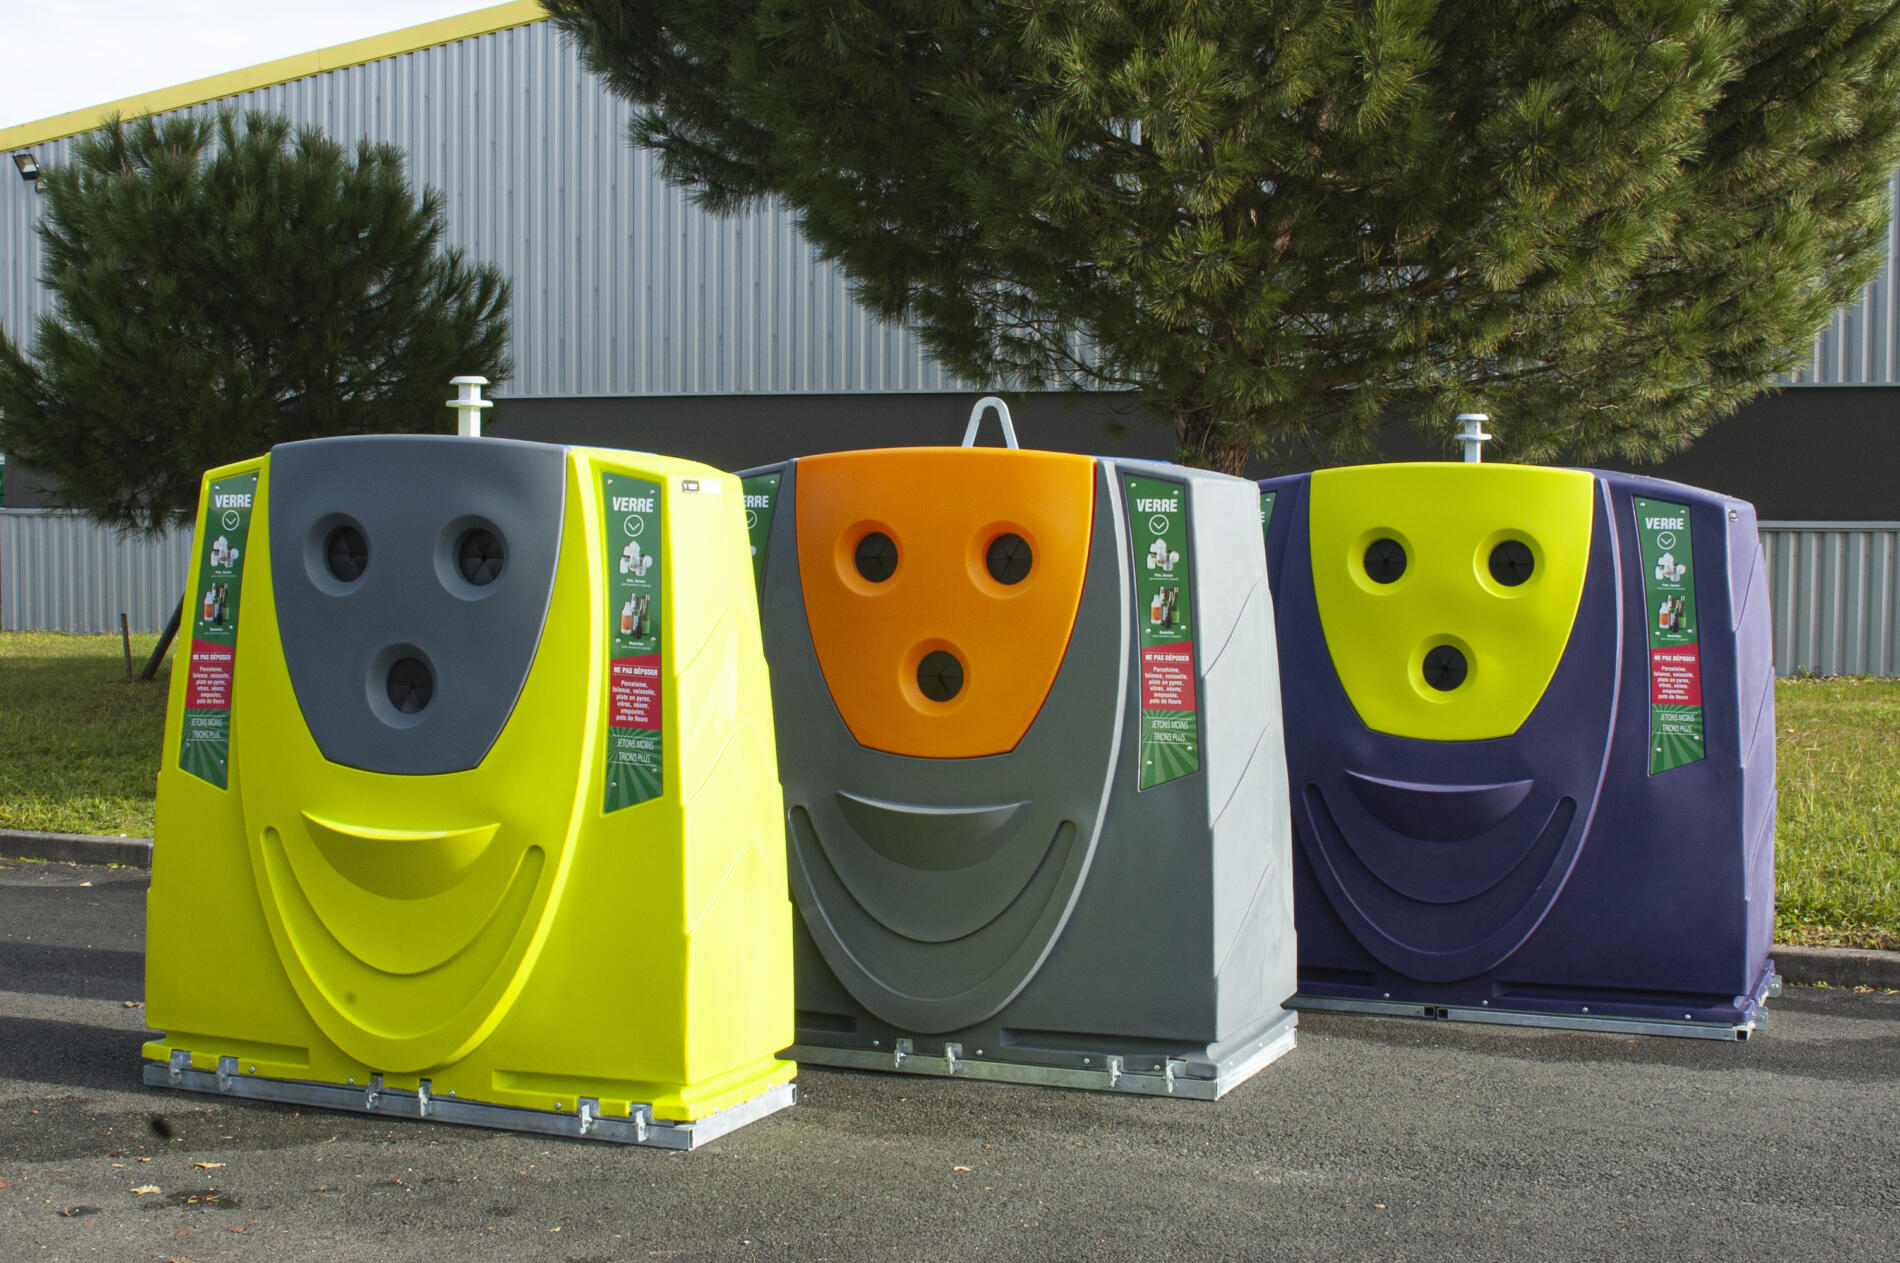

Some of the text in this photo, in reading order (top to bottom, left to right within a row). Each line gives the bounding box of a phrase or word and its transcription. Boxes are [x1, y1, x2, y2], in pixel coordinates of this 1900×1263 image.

[215, 494, 251, 508] VERRE
[613, 496, 654, 512] VERRE
[743, 495, 769, 508] RRE
[1136, 499, 1177, 512] VERRE
[1645, 517, 1684, 530] VERRE
[634, 666, 658, 676] DÉPOSER
[1172, 733, 1185, 742] PLUS
[638, 752, 650, 763] PLUS
